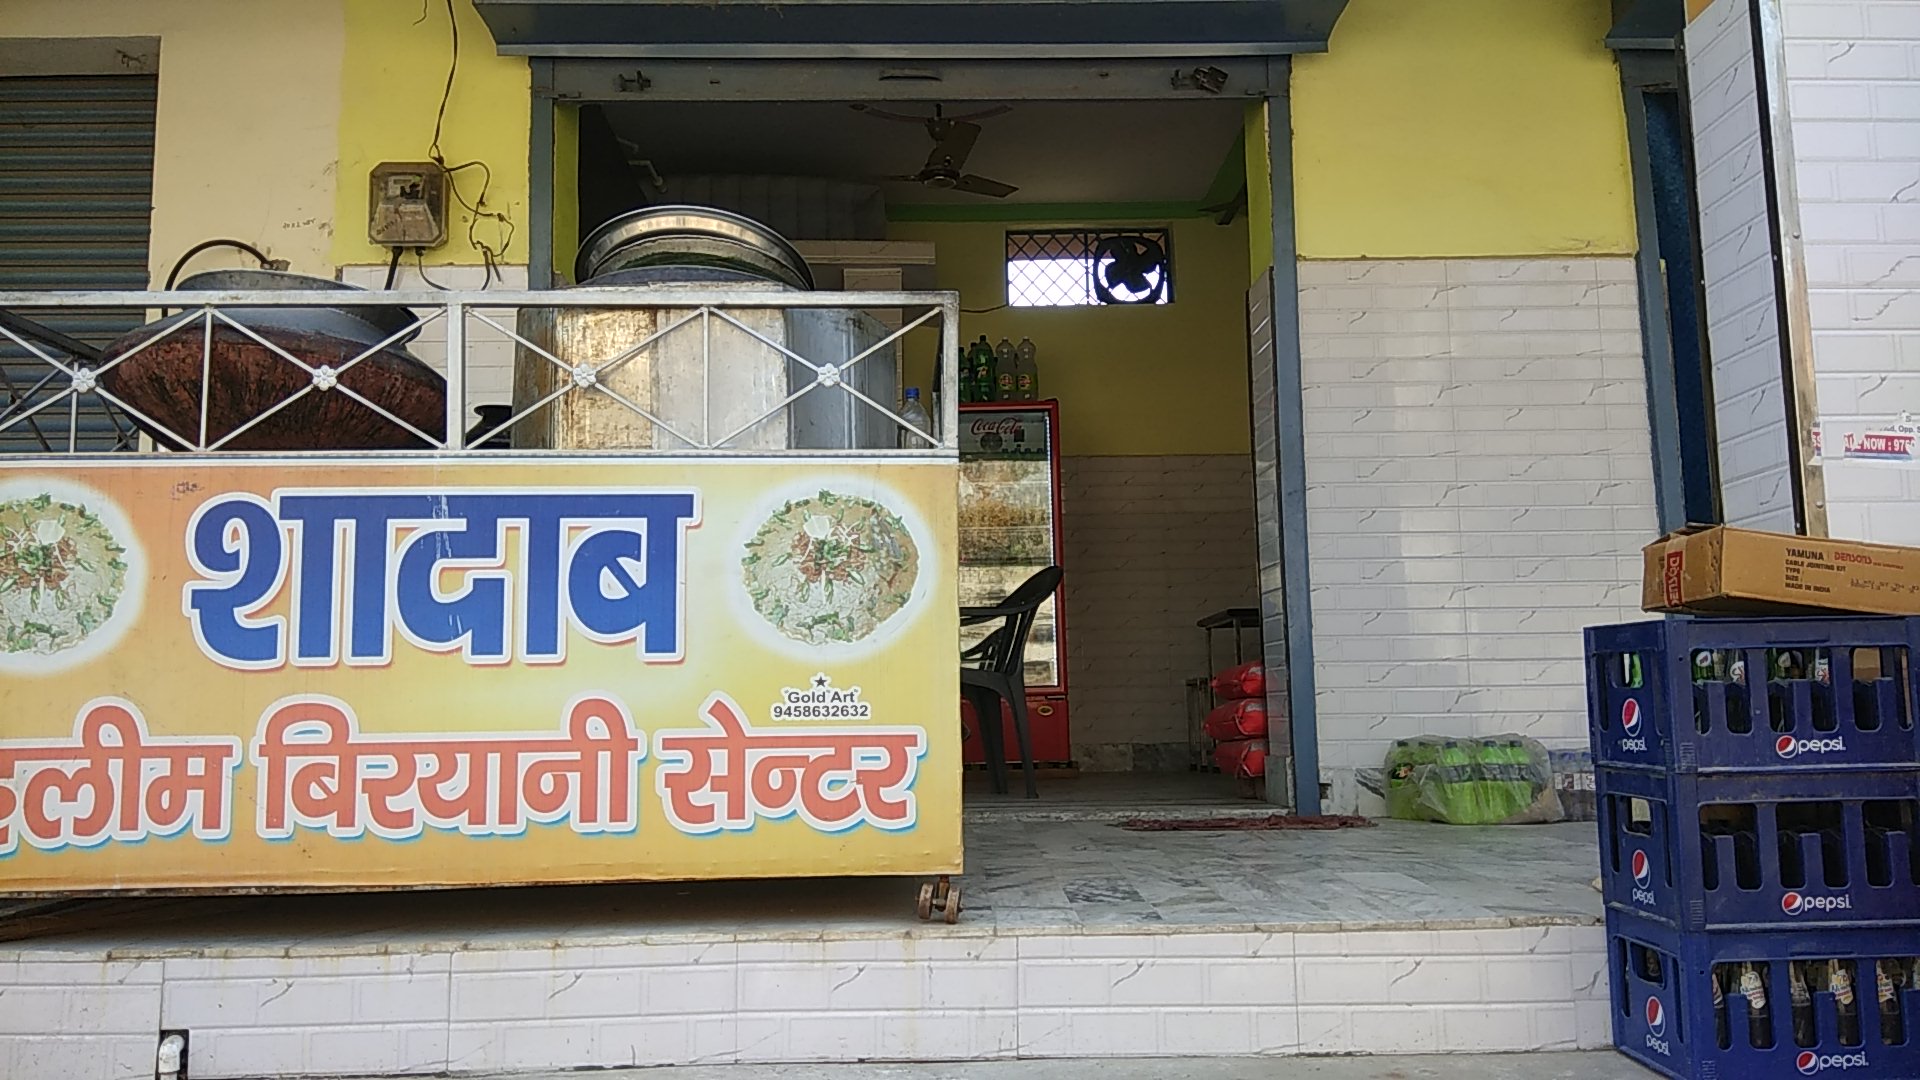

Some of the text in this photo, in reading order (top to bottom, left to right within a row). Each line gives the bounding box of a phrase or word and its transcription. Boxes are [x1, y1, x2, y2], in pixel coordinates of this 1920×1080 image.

[1864, 438, 1886, 450] NOW
[1785, 547, 1824, 561] YAMUNA
[189, 494, 695, 661] शादाब
[773, 704, 868, 718] 9458632632
[1622, 737, 1647, 753] pepsi
[1799, 736, 1846, 754] pepsi
[258, 697, 639, 830] बिरयानी
[661, 698, 919, 825] सेन्टर
[1632, 888, 1656, 906] pepsi
[1805, 894, 1852, 912] pepsi
[1646, 1034, 1670, 1056] pepsi
[1819, 1051, 1869, 1070] pepsi
